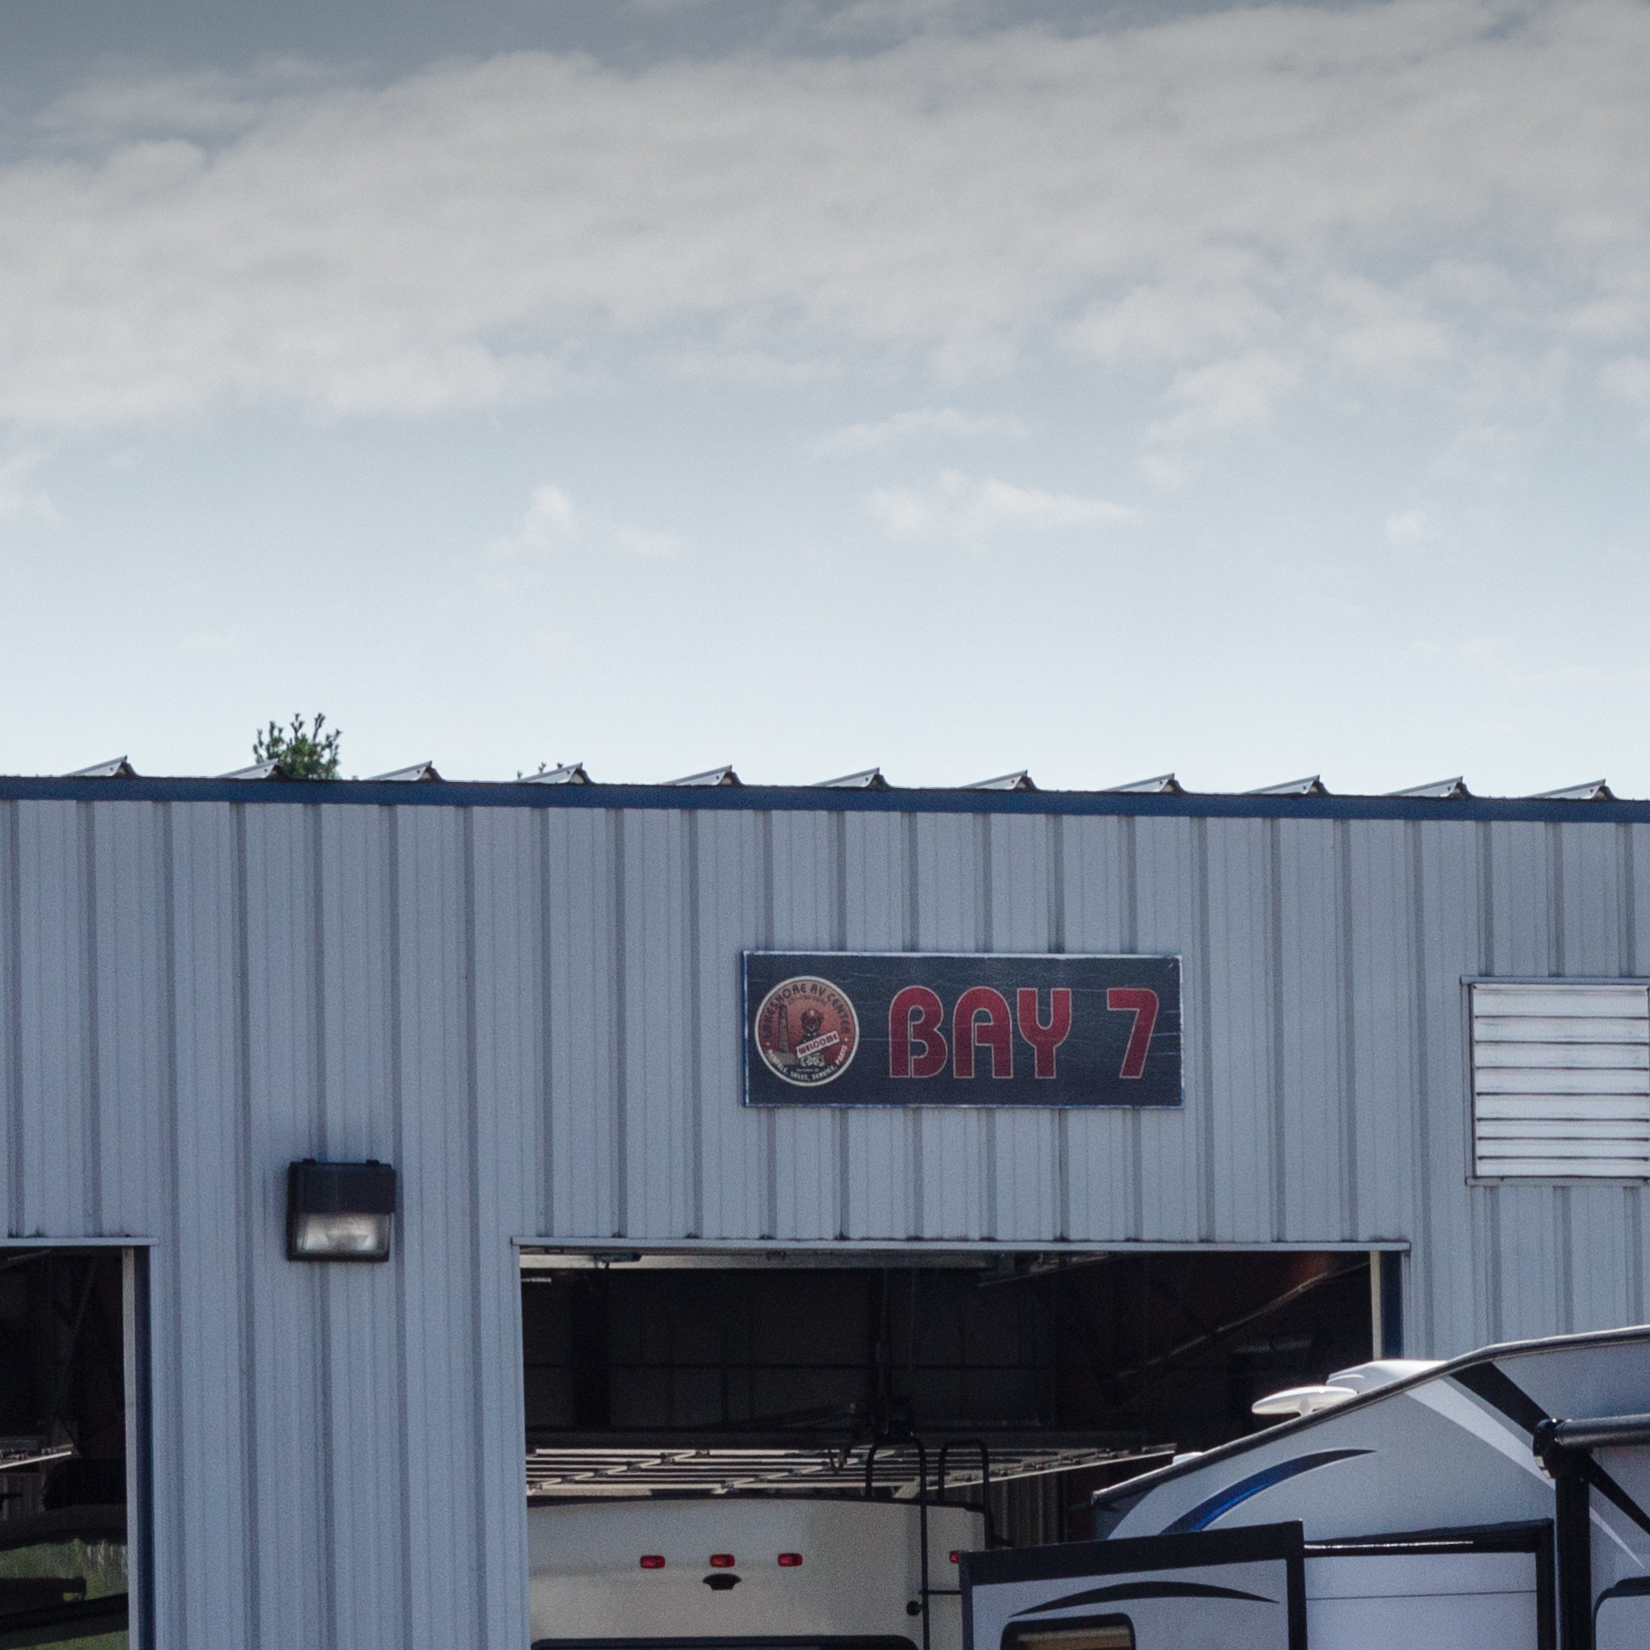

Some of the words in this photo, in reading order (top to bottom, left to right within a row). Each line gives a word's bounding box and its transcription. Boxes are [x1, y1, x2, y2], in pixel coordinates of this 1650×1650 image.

[762, 983, 806, 1040] LAKESHORE
[810, 983, 826, 996] RV
[827, 993, 851, 1034] CENTER
[888, 985, 1072, 1079] BAY
[1107, 987, 1159, 1079] 7
[798, 1034, 838, 1054] WELCOME
